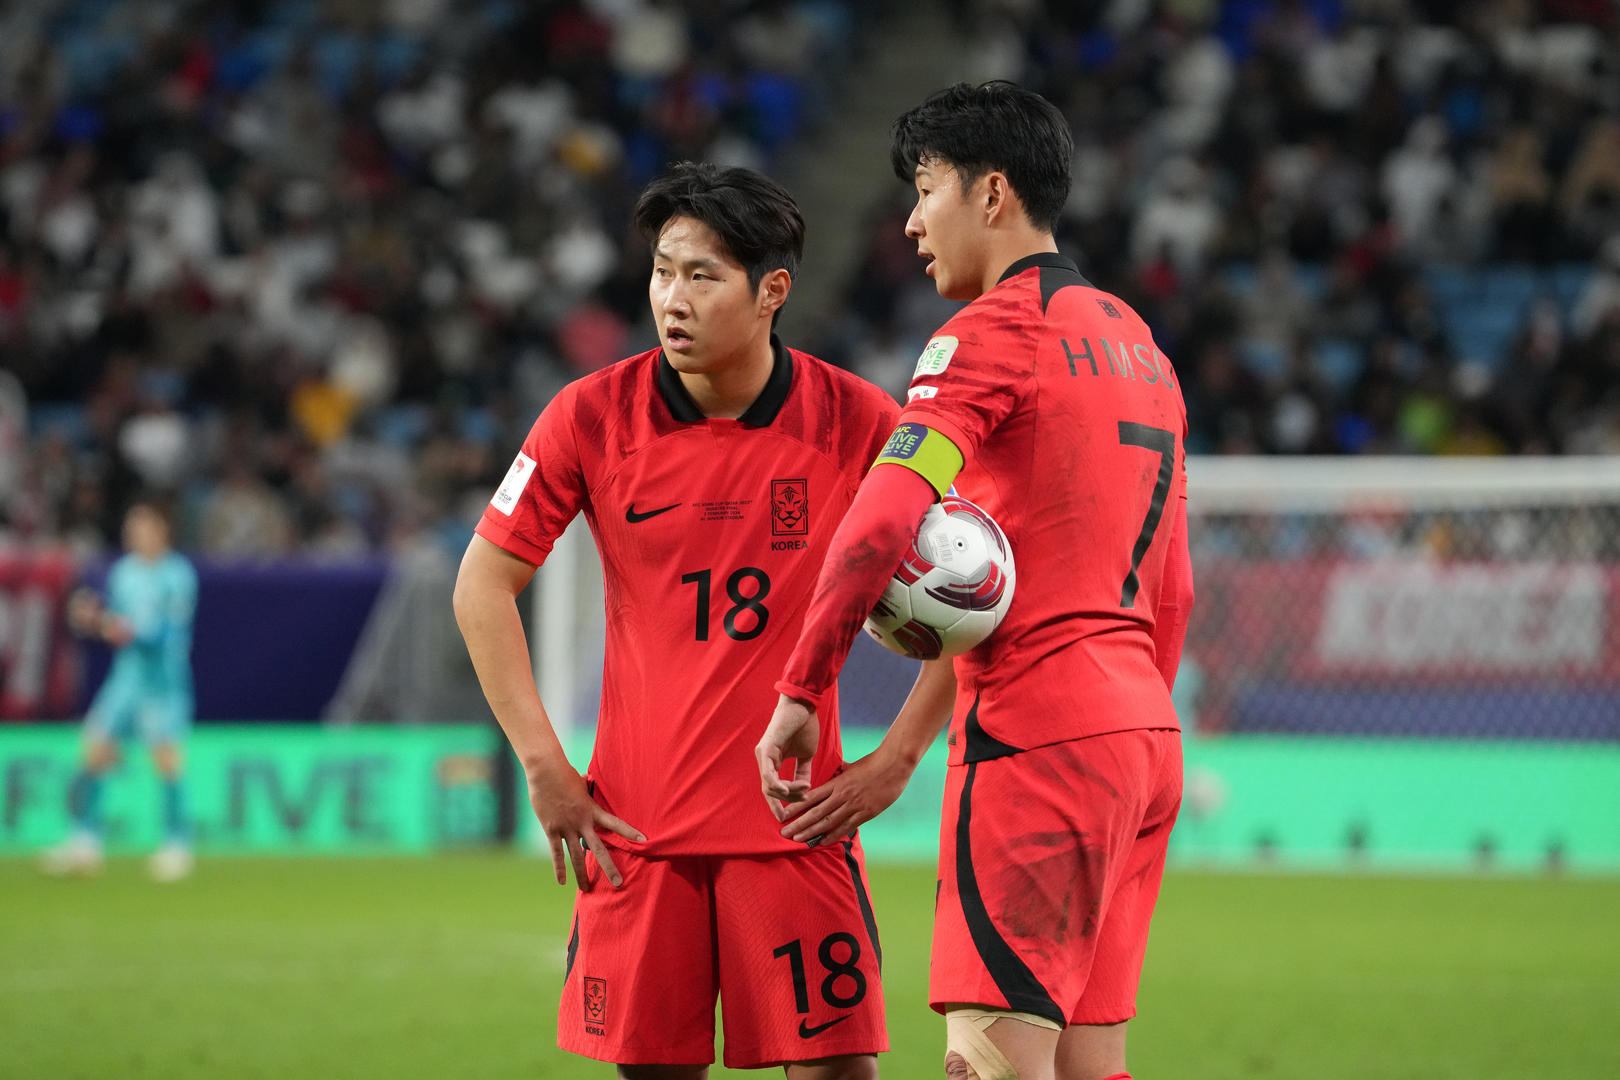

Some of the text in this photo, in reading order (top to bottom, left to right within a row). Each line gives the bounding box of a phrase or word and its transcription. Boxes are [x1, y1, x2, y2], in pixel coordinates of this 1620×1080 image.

[889, 433, 919, 446] LIVE
[1118, 420, 1176, 609] 7
[771, 540, 809, 551] KOREA
[681, 566, 771, 642] 18
[773, 932, 867, 1014] 18
[585, 1026, 606, 1037] KOREA
